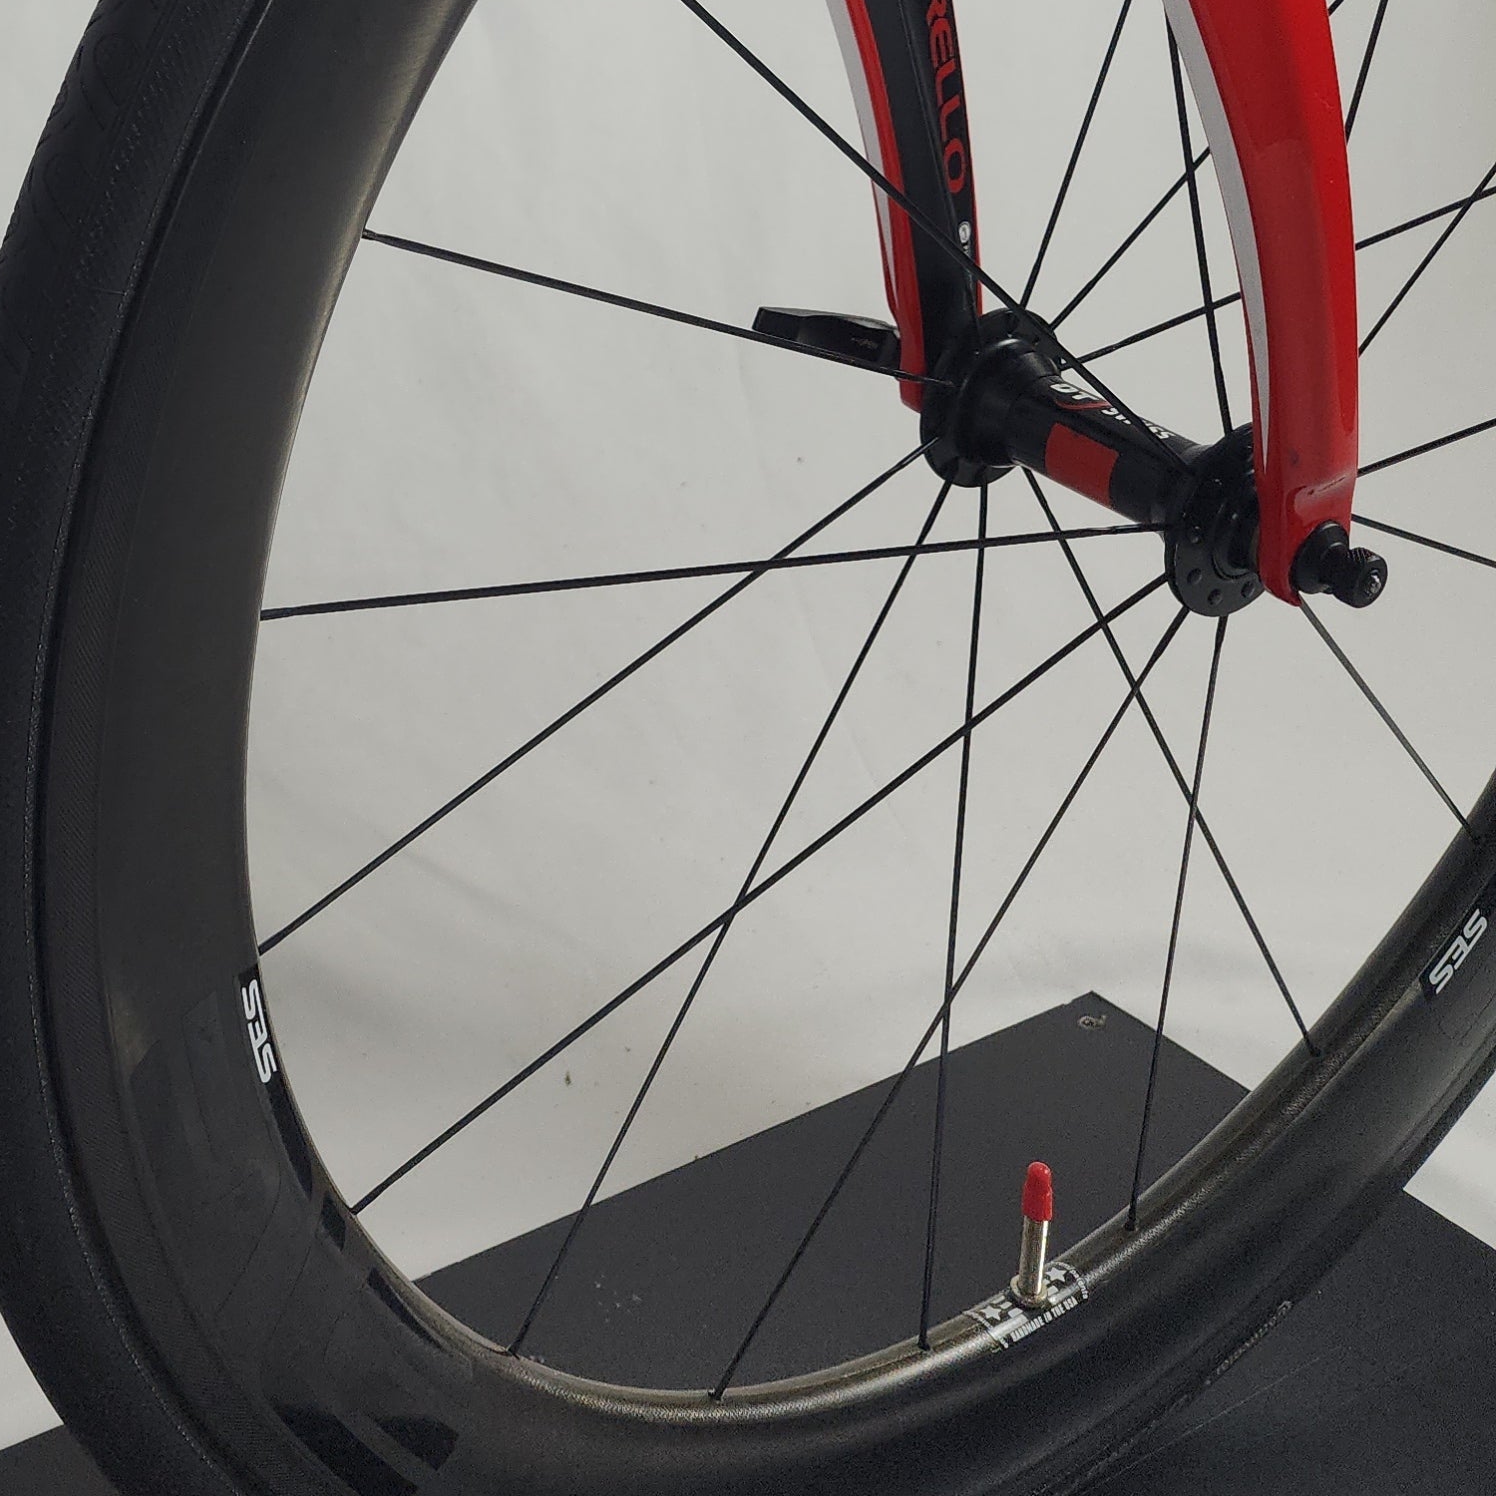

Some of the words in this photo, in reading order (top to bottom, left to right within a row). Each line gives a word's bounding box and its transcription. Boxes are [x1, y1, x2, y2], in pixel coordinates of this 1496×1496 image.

[1427, 907, 1488, 995] SES
[240, 978, 278, 1085] SES
[1051, 1304, 1066, 1318] THE
[1063, 1295, 1078, 1310] USA
